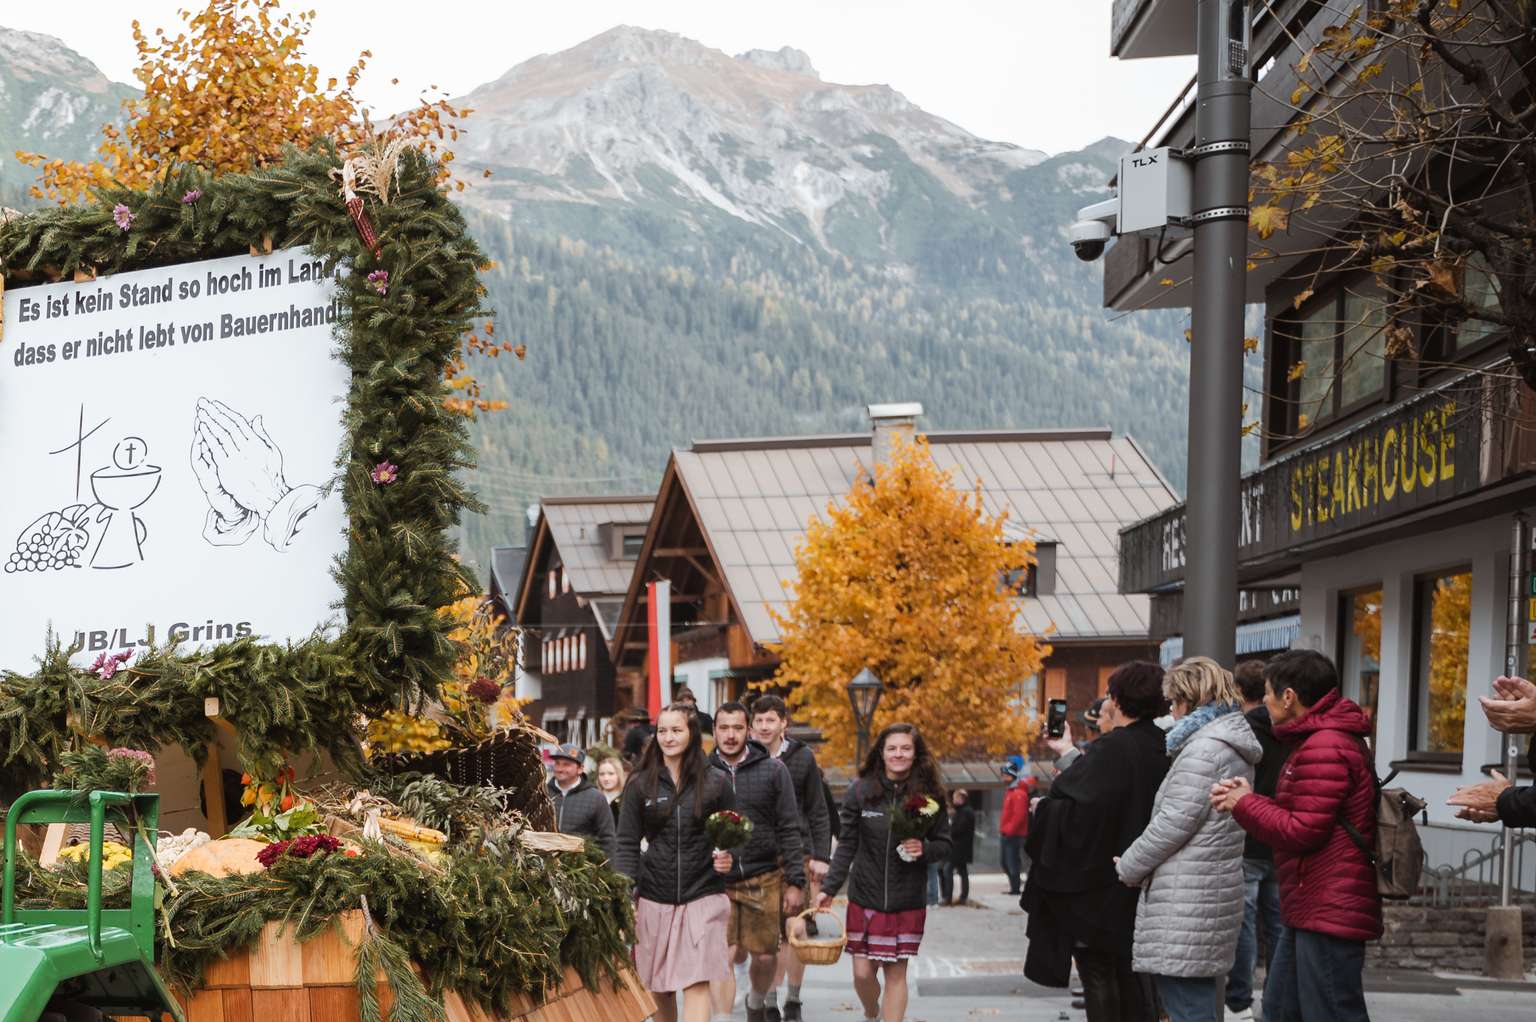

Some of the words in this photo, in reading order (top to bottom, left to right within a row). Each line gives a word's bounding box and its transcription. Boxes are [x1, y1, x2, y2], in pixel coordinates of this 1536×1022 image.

[18, 298, 41, 323] Es
[46, 293, 69, 319] ist
[75, 288, 113, 315] kein
[119, 277, 173, 308] Stand
[179, 279, 201, 300] so
[207, 266, 252, 297] hoch
[259, 264, 282, 289] im
[13, 341, 57, 367] dass
[62, 340, 82, 361] er
[86, 327, 134, 358] nicht
[138, 322, 176, 351] lebt
[180, 320, 214, 345] von
[1290, 400, 1457, 531] STEAKHOUSE
[167, 619, 253, 644] Grins
